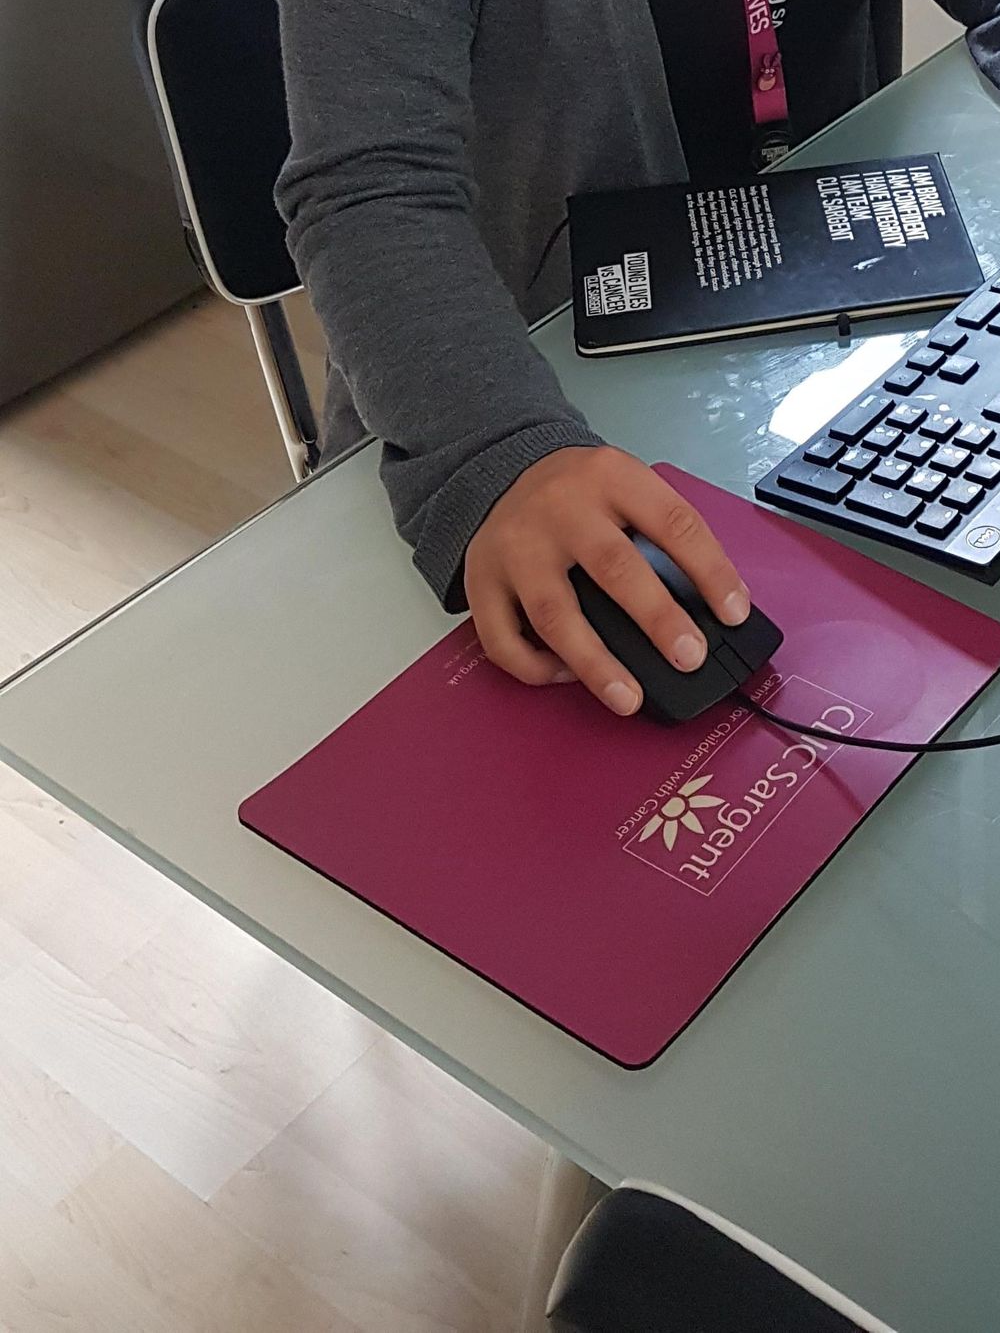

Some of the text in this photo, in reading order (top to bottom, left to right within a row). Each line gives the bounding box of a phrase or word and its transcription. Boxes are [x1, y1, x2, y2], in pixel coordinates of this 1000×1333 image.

[840, 179, 865, 195] AM
[864, 176, 891, 201] HAVE
[887, 174, 911, 190] AM
[910, 171, 934, 187] AM
[815, 176, 854, 241] CLIC SARGENT
[845, 194, 872, 221] TEAM
[892, 189, 929, 241] CONFIDENT
[915, 187, 946, 219] BRAVE
[721, 213, 732, 229] people
[871, 201, 906, 248] INTEGRITY
[730, 199, 740, 217] Sargent
[742, 259, 752, 280] children
[752, 247, 763, 268] Through
[764, 252, 772, 268] cancer
[602, 277, 626, 313] CANCER
[627, 254, 648, 309] YOUNG LIVES
[711, 277, 720, 292] focus
[615, 673, 783, 840] Carin for Children with Cancer
[679, 705, 855, 880] CLIC Sargent
